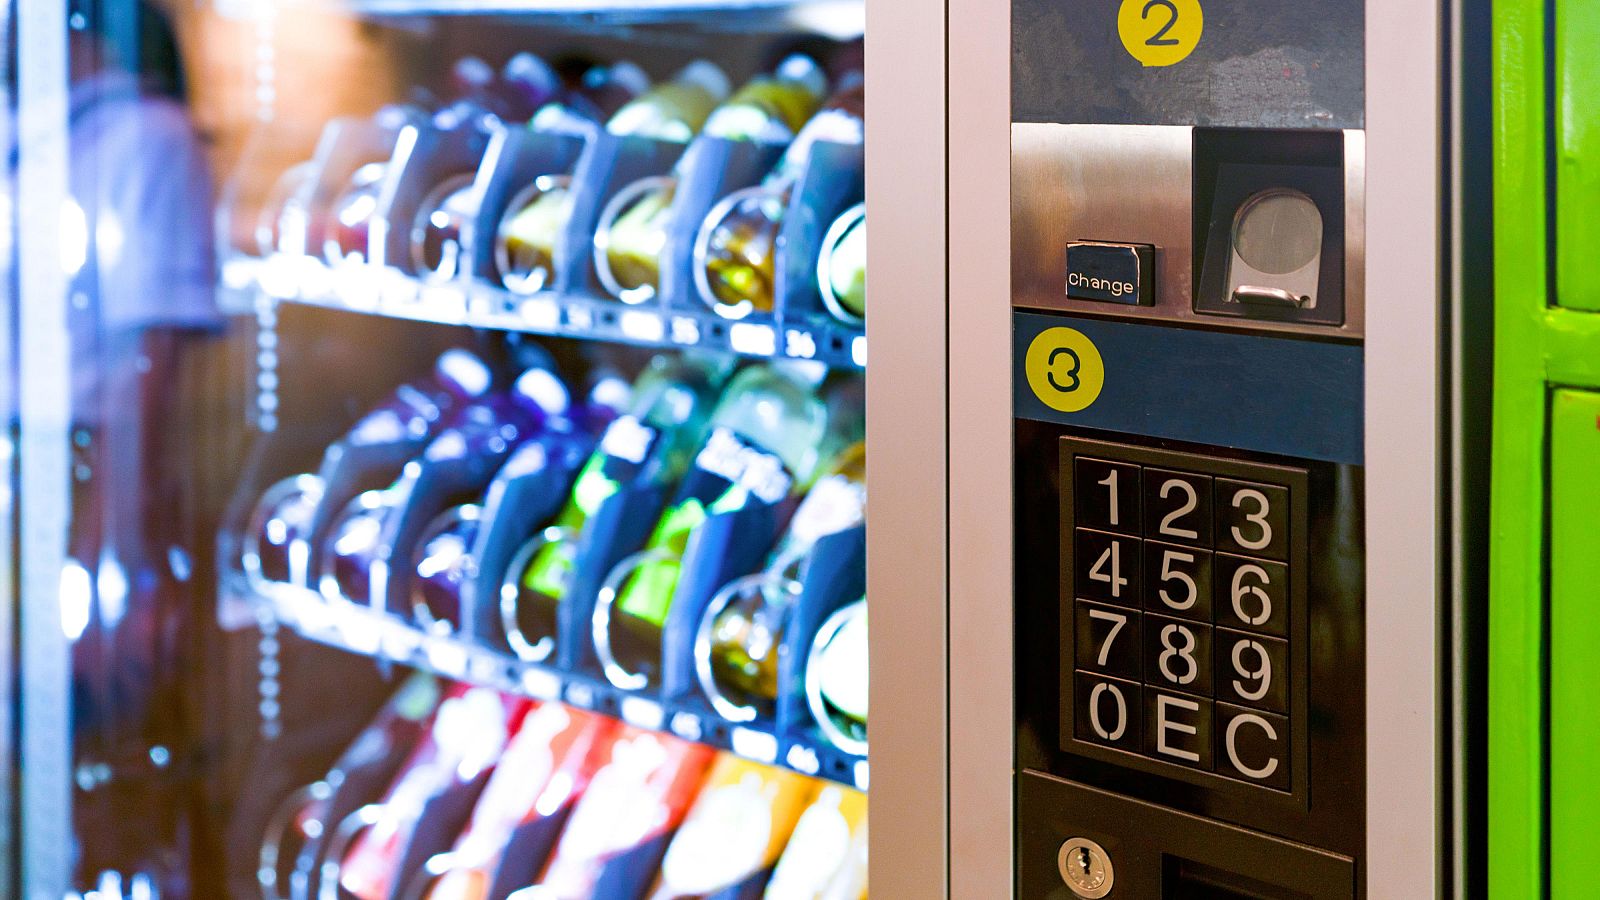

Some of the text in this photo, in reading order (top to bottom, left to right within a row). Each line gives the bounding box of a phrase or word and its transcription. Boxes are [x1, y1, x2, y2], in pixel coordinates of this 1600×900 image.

[1142, 0, 1180, 46] 2
[1068, 272, 1134, 297] Change
[1047, 346, 1081, 393] 3
[1097, 469, 1273, 551] 1 2 3
[1088, 540, 1273, 626] 4 5 6
[1088, 608, 1273, 702] 7 8 9
[1089, 682, 1279, 780] 0 E C
